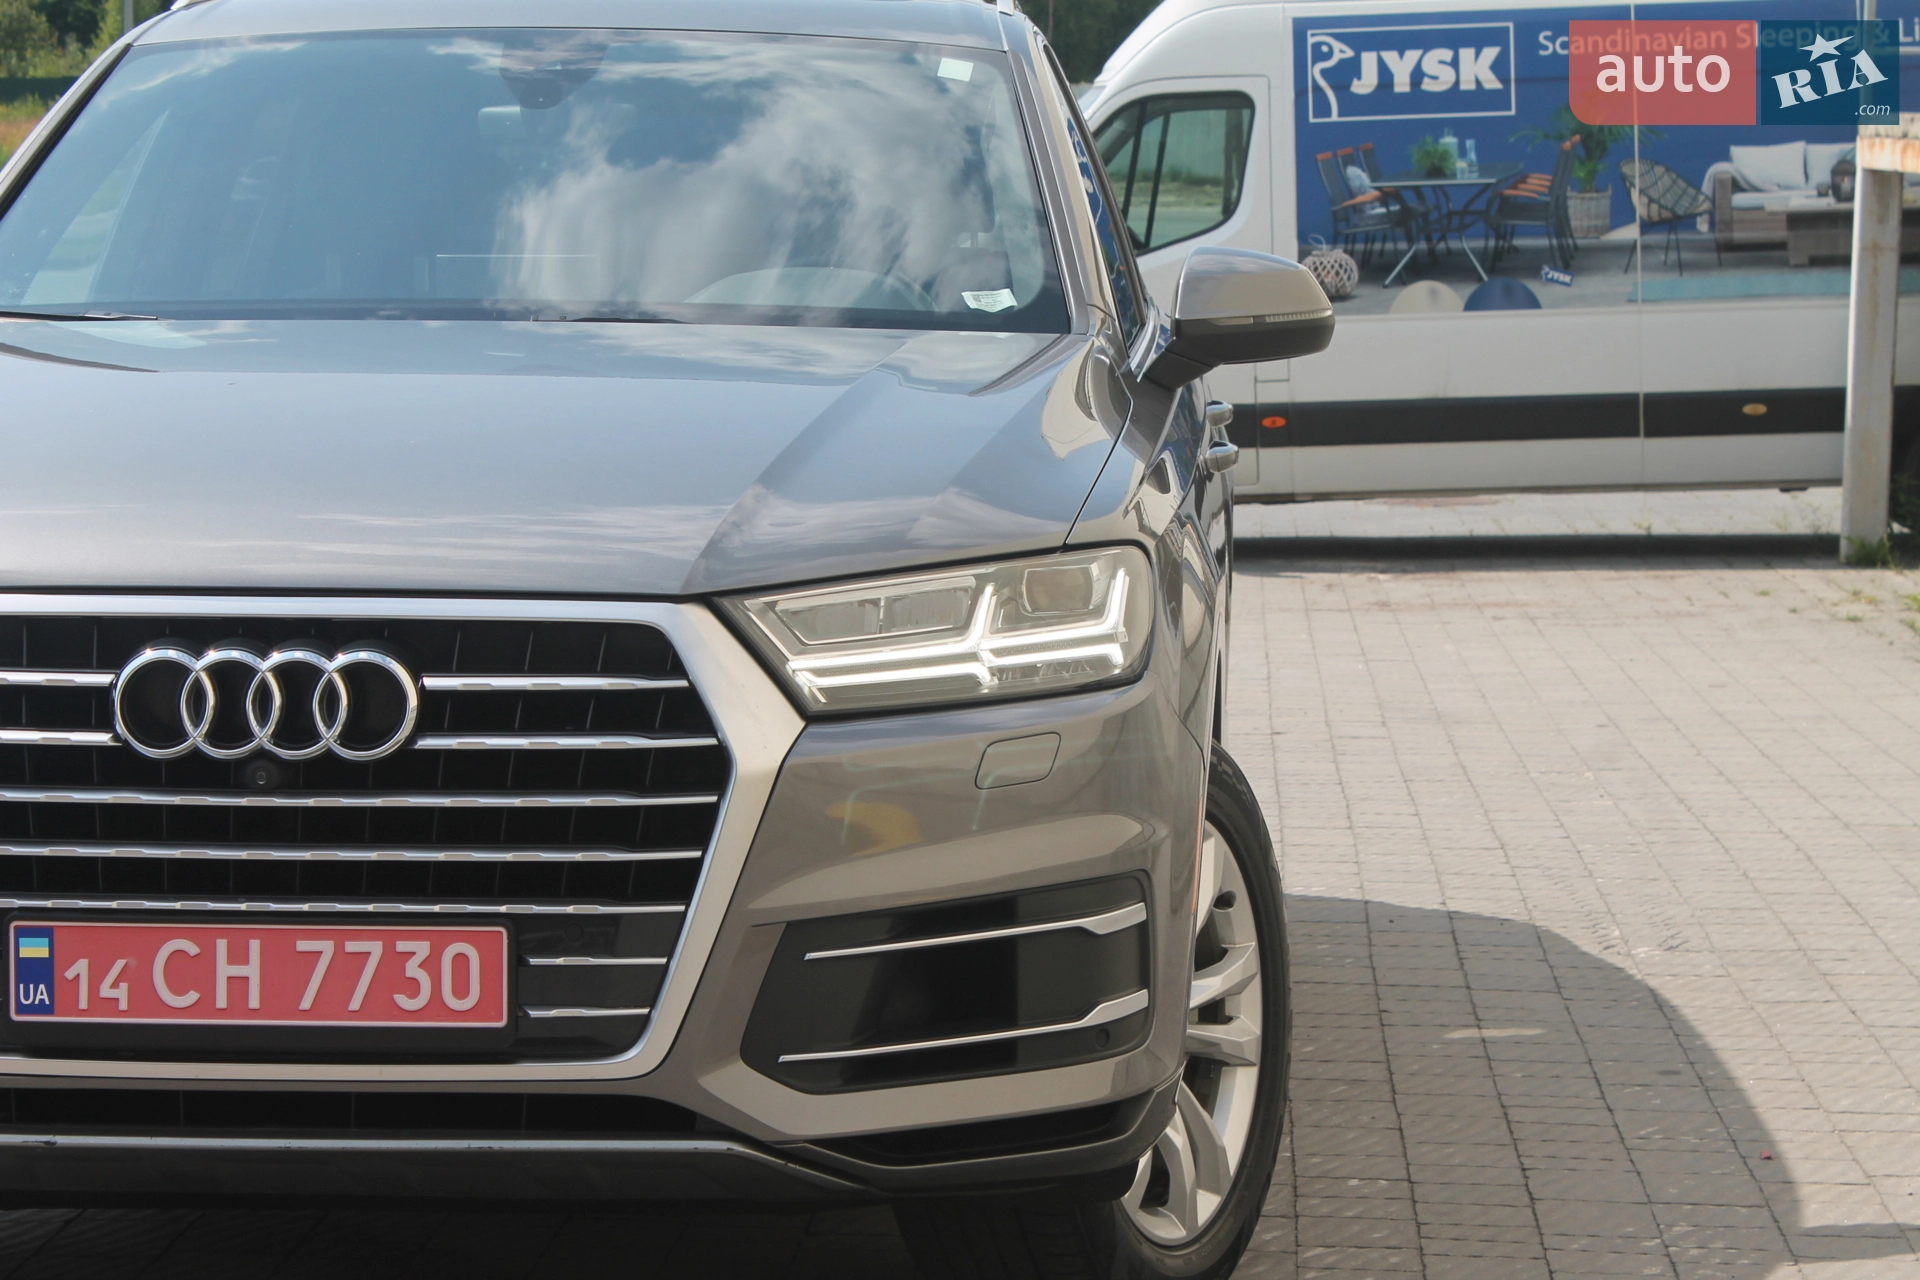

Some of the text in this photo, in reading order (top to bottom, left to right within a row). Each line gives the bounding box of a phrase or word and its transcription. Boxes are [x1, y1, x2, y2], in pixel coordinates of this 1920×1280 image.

[1538, 26, 1727, 56] Scandinavian
[1350, 46, 1504, 95] JYSK
[18, 983, 50, 1006] UA
[63, 938, 481, 1012] 14 CH 7730
